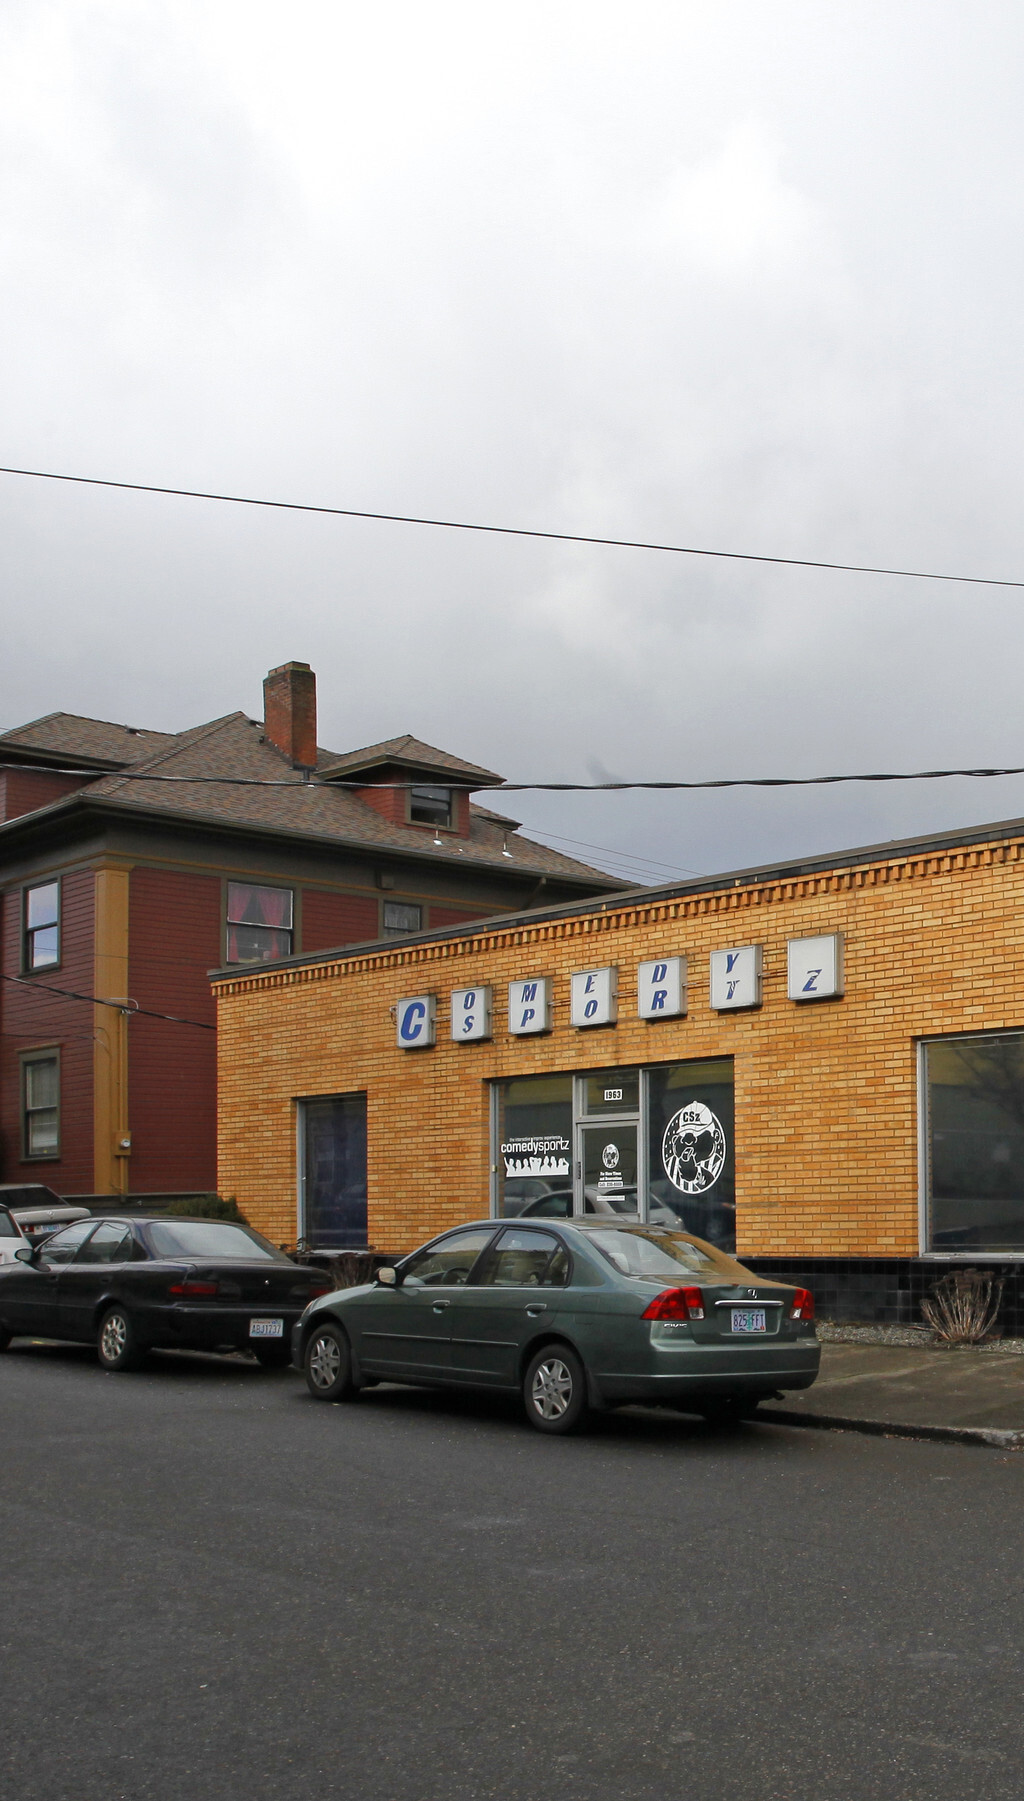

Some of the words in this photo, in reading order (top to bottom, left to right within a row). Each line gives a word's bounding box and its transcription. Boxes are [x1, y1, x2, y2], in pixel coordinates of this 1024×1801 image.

[605, 1090, 622, 1100] 1963
[683, 1111, 701, 1122] CSz
[500, 1137, 570, 1155] comedysportz
[733, 1313, 747, 1327] 825
[751, 1313, 764, 1327] FFT
[251, 1324, 281, 1334] ABJ1737
